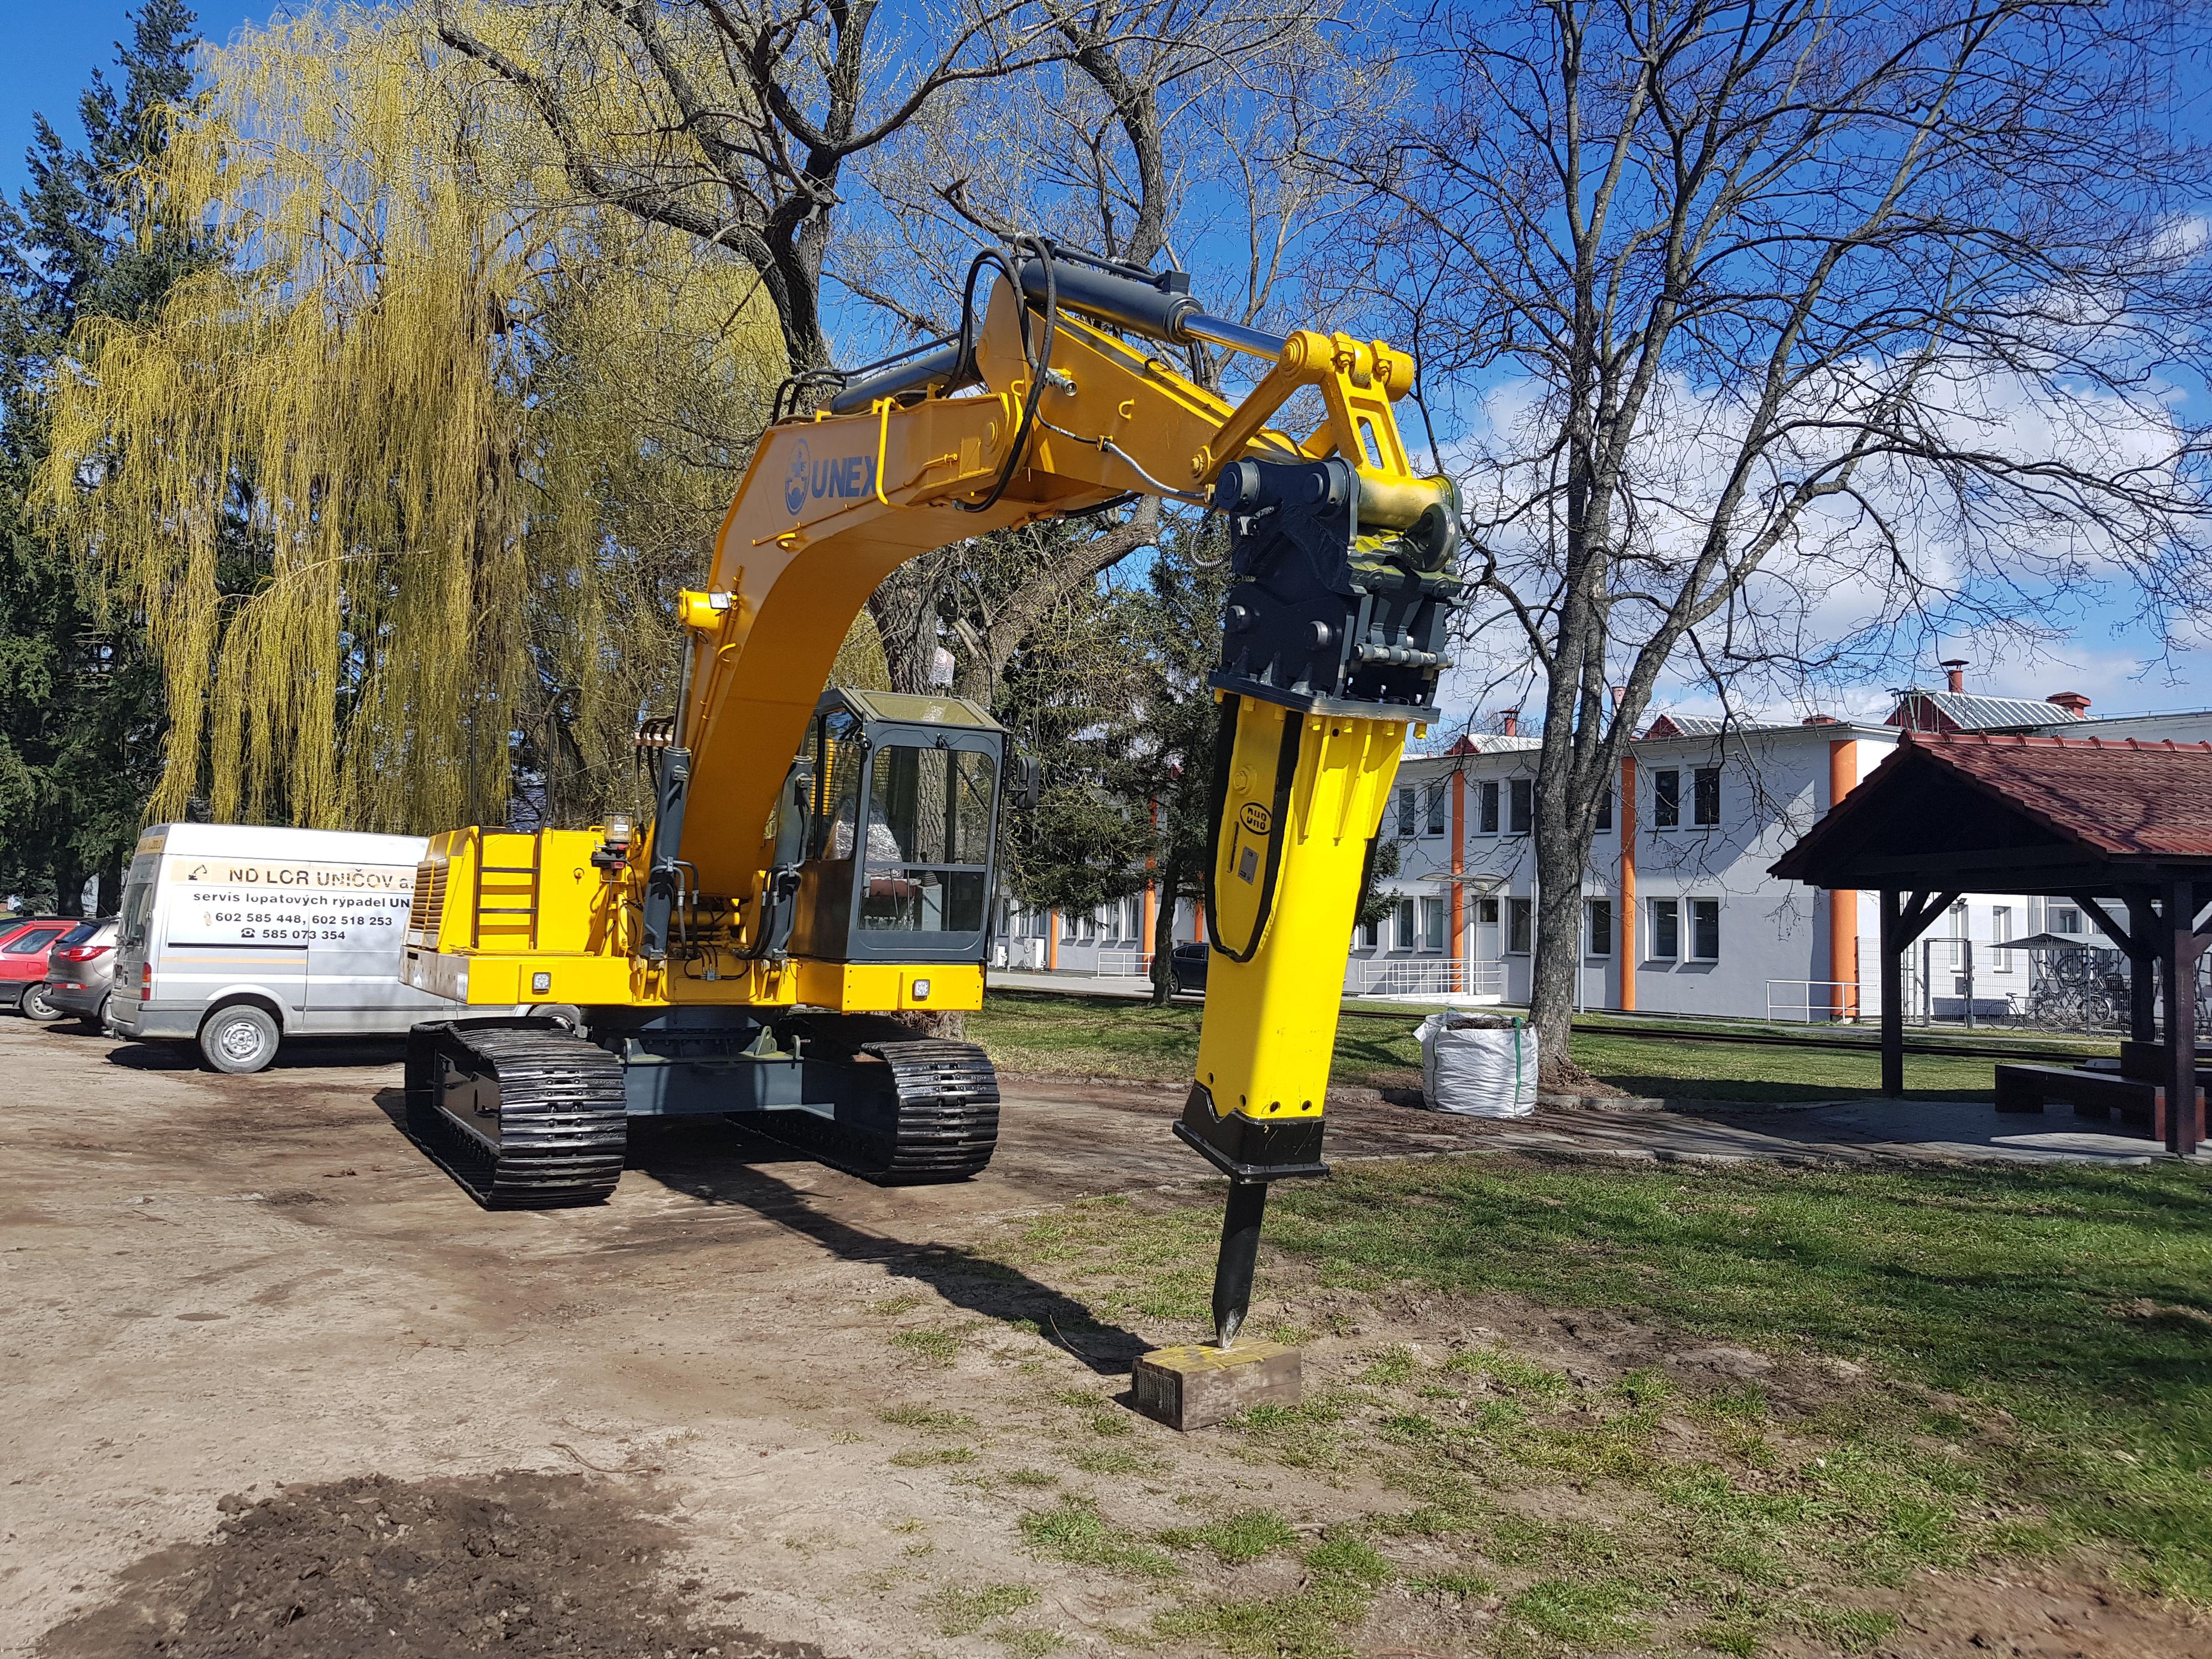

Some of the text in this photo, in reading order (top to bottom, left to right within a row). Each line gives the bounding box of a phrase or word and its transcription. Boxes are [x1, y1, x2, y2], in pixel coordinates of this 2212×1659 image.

[812, 456, 878, 498] UNEX
[229, 868, 259, 883] ND
[317, 869, 393, 888] UNIČOV
[193, 891, 413, 908] servis lopatových rýpadel UN
[215, 912, 392, 926] 602 585 448, 602 518 253
[262, 930, 346, 940] 585 073 354
